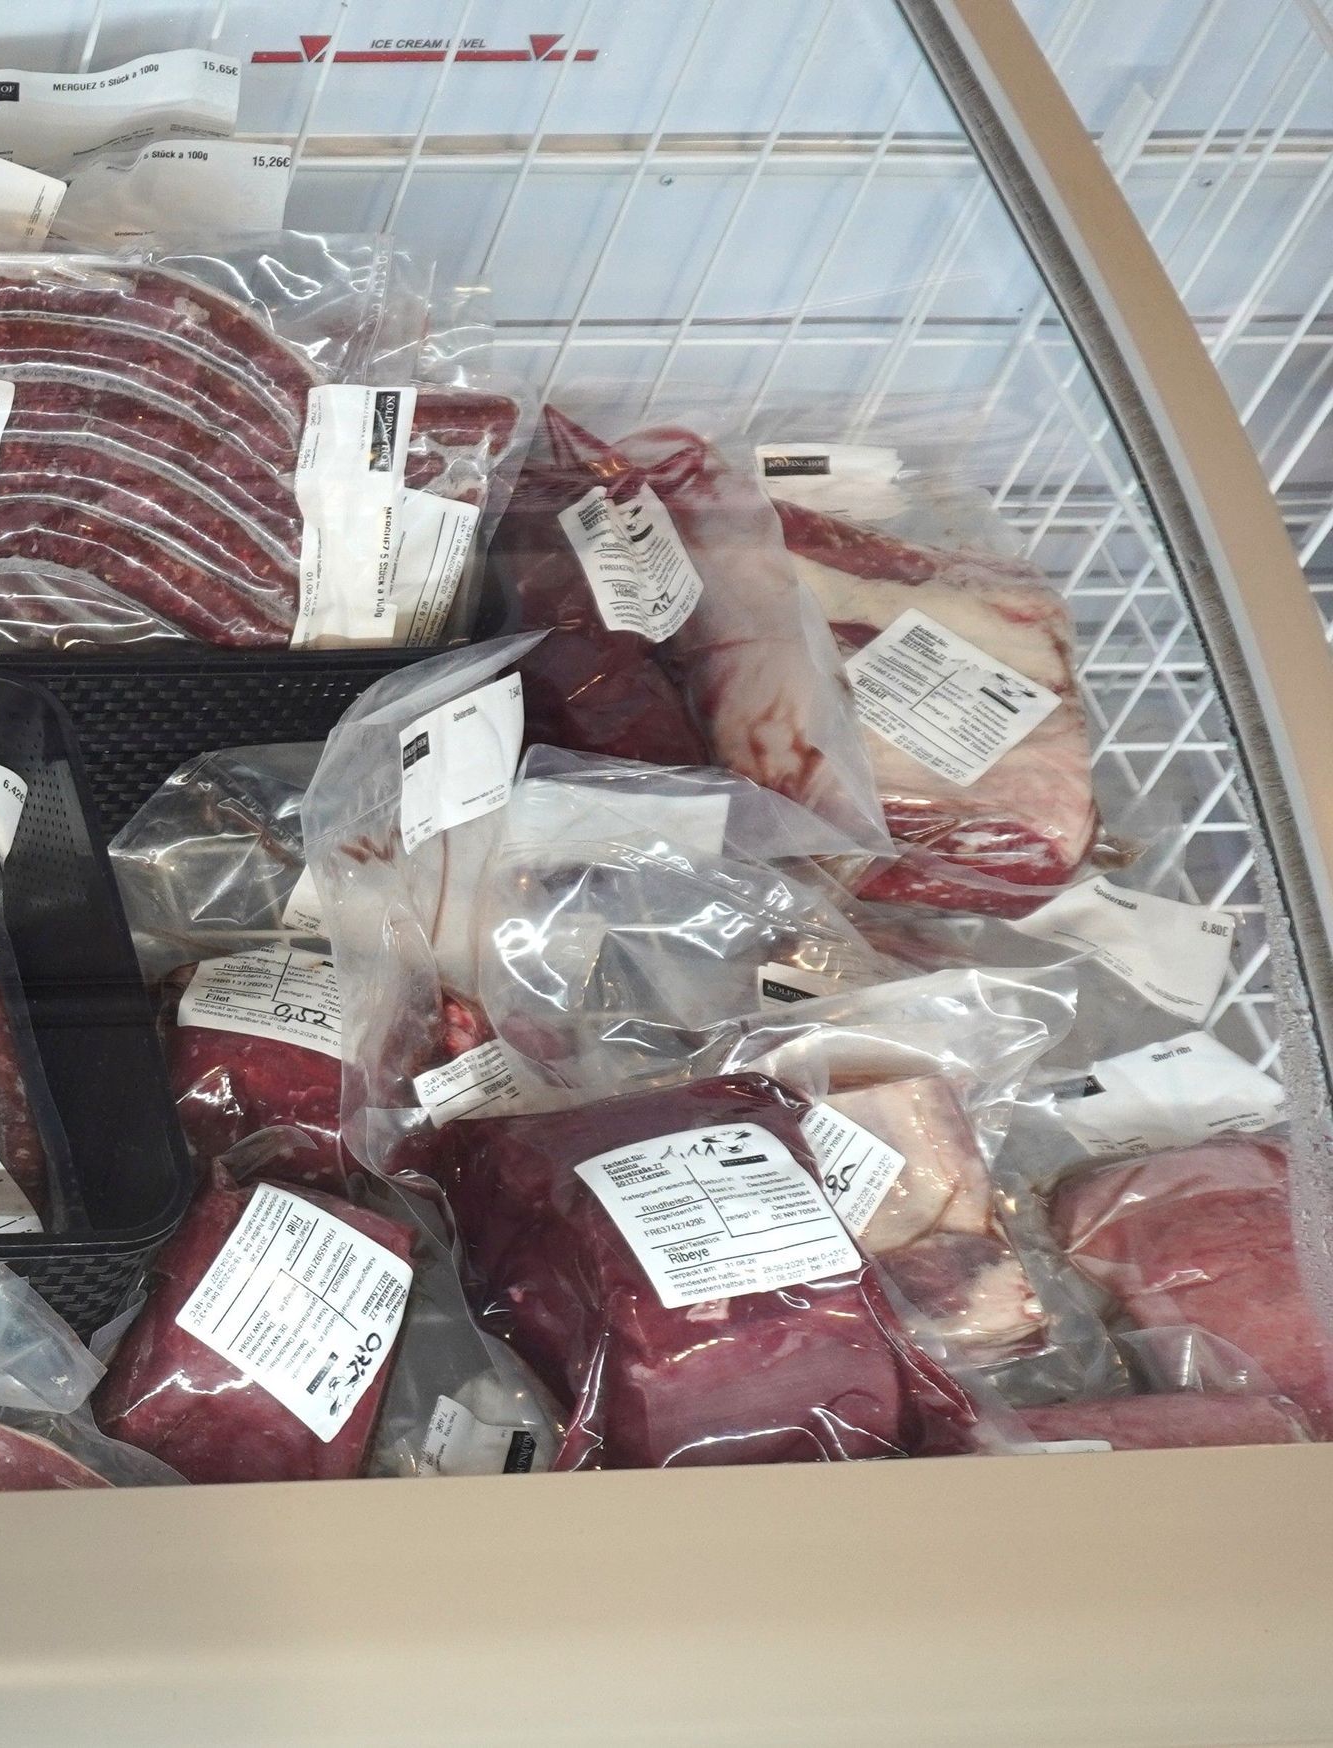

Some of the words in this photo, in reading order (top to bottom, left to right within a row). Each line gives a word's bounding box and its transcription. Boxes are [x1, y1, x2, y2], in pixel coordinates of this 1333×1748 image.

[371, 39, 394, 49] ICE
[396, 39, 443, 49] CREAM
[445, 39, 487, 48] LVEL
[203, 60, 238, 76] 15,65€
[53, 82, 97, 92] MERGUEZ
[108, 75, 130, 87] Stück
[132, 71, 138, 79] a
[140, 63, 159, 77] 100g
[152, 150, 176, 159] Stück
[188, 150, 208, 161] 100g
[252, 155, 291, 168] 15,26€
[383, 395, 396, 442] KOLPING
[377, 562, 388, 585] Stück
[303, 572, 314, 617] 01.09.2027
[3, 779, 25, 804] 6,42€
[297, 918, 319, 930] 7,49€
[1201, 920, 1229, 937] 8,80€
[223, 963, 271, 973] Rindfleisch
[195, 1002, 225, 1010] verpackt
[205, 993, 230, 1003] Filet
[274, 1003, 335, 1030] 0,52
[192, 1008, 232, 1019] mindestens
[233, 1015, 259, 1024] haltbar
[277, 1025, 318, 1040] 09-03-2026
[320, 1035, 331, 1044] bei
[1151, 1050, 1176, 1063] Short
[1176, 1046, 1192, 1057] ribs
[611, 1166, 651, 1182] Neustraße
[652, 1162, 664, 1172] 77
[615, 1177, 640, 1188] 50171
[641, 1169, 671, 1182] Kerpen
[641, 1195, 694, 1213] Rindfleisch
[771, 1212, 783, 1220] DE
[784, 1209, 797, 1218] NW
[798, 1206, 821, 1216] 70584
[284, 1214, 304, 1235] Filet
[644, 1217, 706, 1238] FR6374274295
[302, 1227, 337, 1283] FR5455921369
[668, 1247, 710, 1264] Ribeye
[330, 1253, 358, 1294] Rindfleisch
[669, 1266, 702, 1280] verpackt
[673, 1274, 717, 1289] mindestens
[806, 1256, 819, 1264] bei
[250, 1321, 265, 1335] NW
[237, 1334, 257, 1354] 70584
